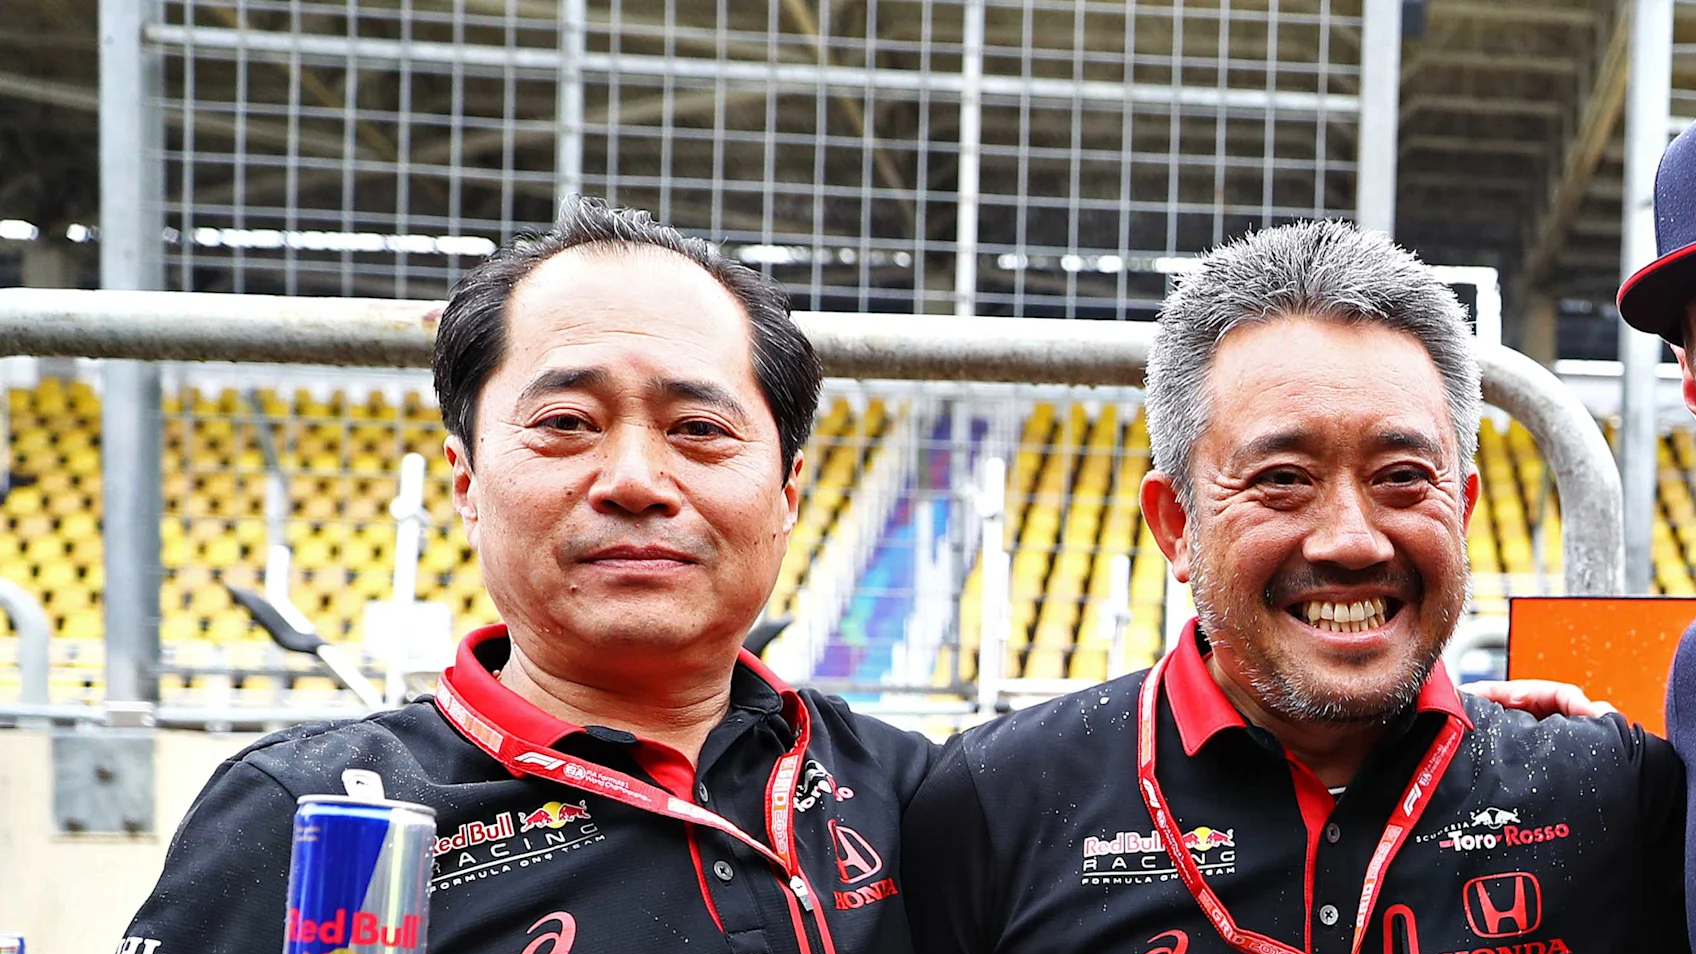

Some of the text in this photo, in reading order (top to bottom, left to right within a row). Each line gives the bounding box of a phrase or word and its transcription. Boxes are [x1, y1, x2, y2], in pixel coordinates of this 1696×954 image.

[468, 810, 515, 846] Bull
[1084, 830, 1166, 858] Red Bul
[1081, 876, 1153, 886] FORMULA
[1159, 873, 1179, 882] ON
[350, 911, 420, 950] Bull
